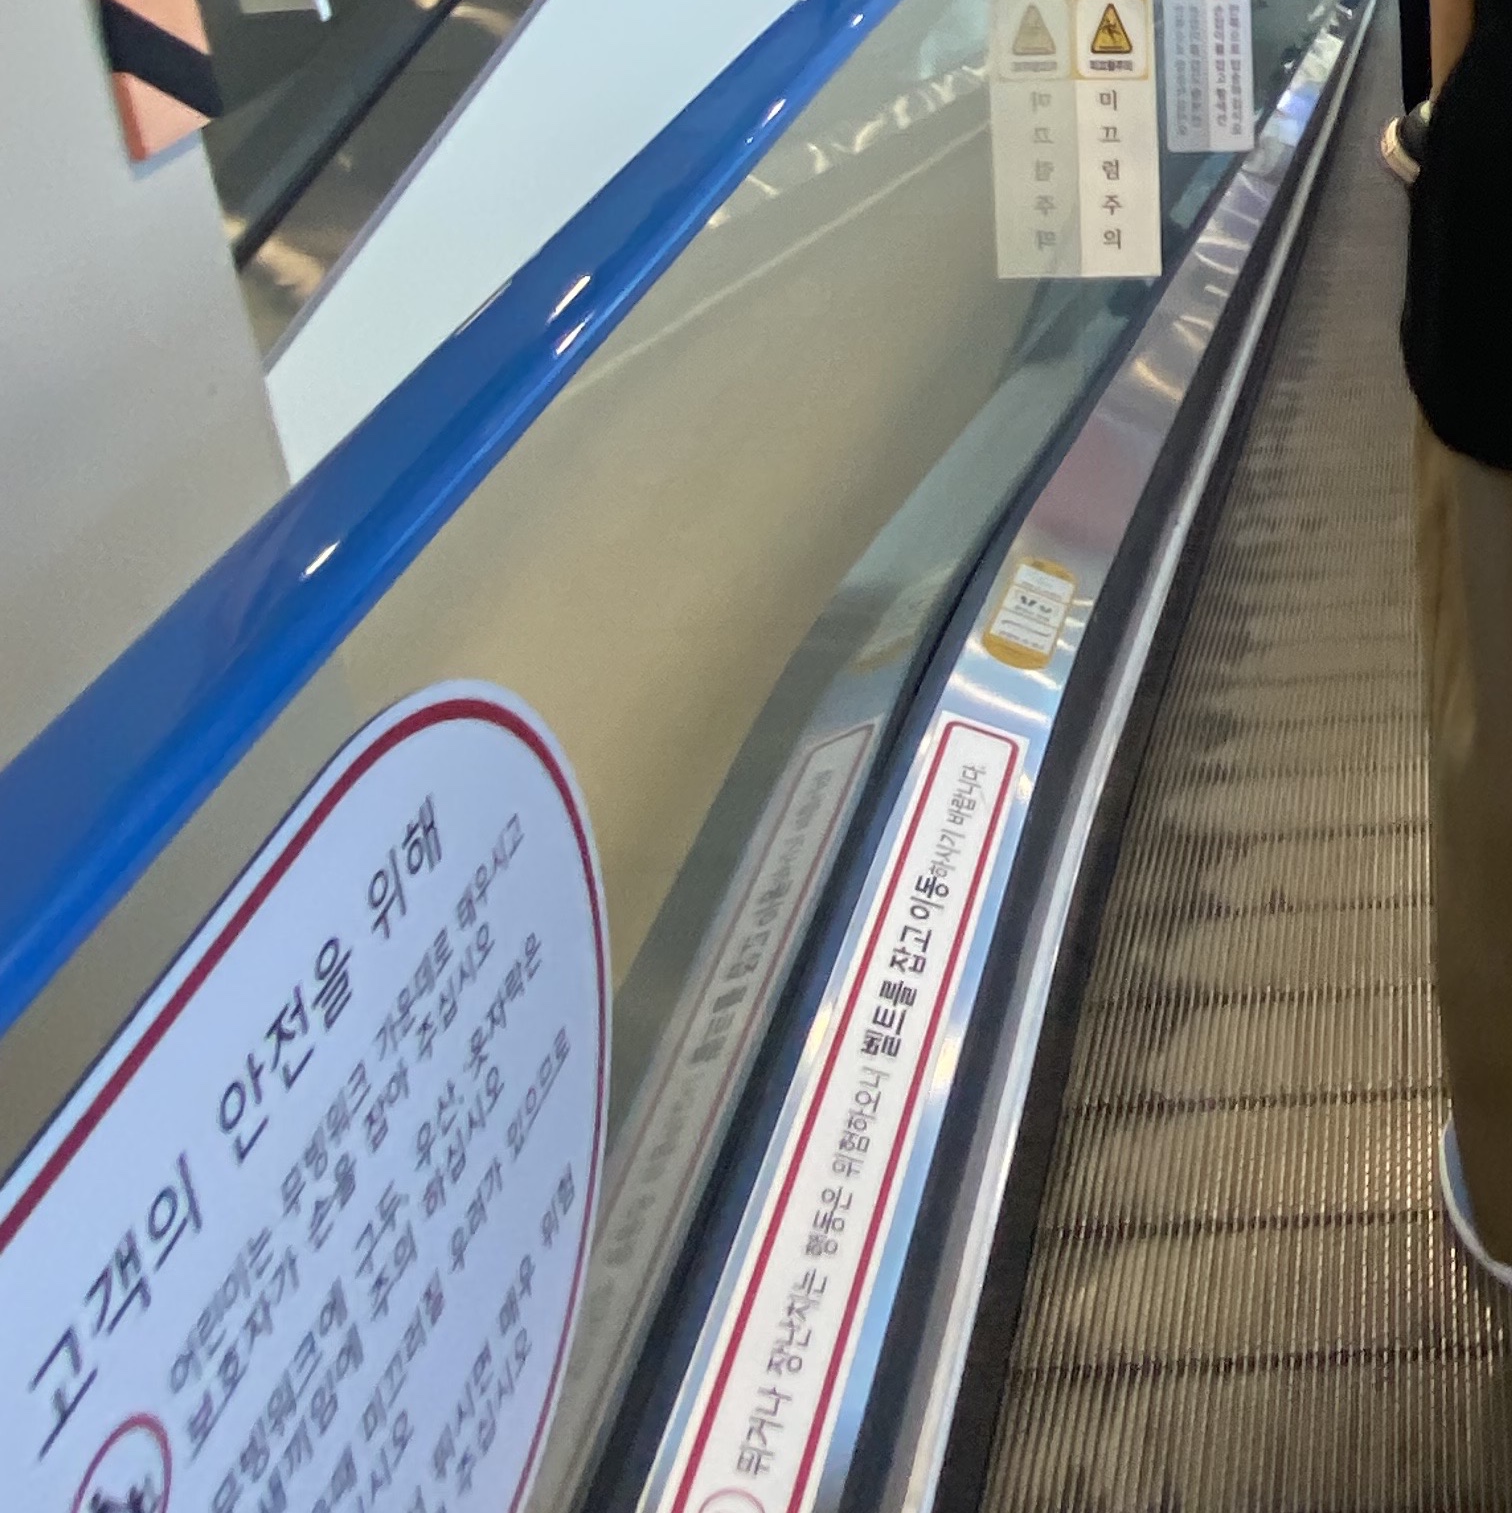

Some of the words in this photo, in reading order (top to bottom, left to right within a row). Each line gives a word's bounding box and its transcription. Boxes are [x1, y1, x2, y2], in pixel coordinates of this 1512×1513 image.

[1099, 90, 1123, 250] 미끄럼주의
[909, 827, 965, 920] 이동하시기
[889, 923, 932, 975] 잡고
[860, 978, 917, 1058] 벨트를
[28, 1148, 203, 1462] 고객의
[218, 935, 353, 1167] 안전을
[368, 791, 442, 939] 위해
[831, 1067, 890, 1179] 위험하오니
[170, 1226, 274, 1393] 어린이는
[281, 1059, 371, 1218] 무빙워크
[187, 1244, 300, 1464] 보호자가
[308, 1152, 357, 1253] 손을
[364, 1056, 410, 1154] 잡아
[416, 921, 496, 1062] 주십시오
[369, 1220, 418, 1322] 주의
[422, 1065, 505, 1219] 하십시오
[804, 1186, 852, 1257] 행동은
[766, 1266, 829, 1377] 장난치는
[735, 1386, 793, 1478] 뛰거나
